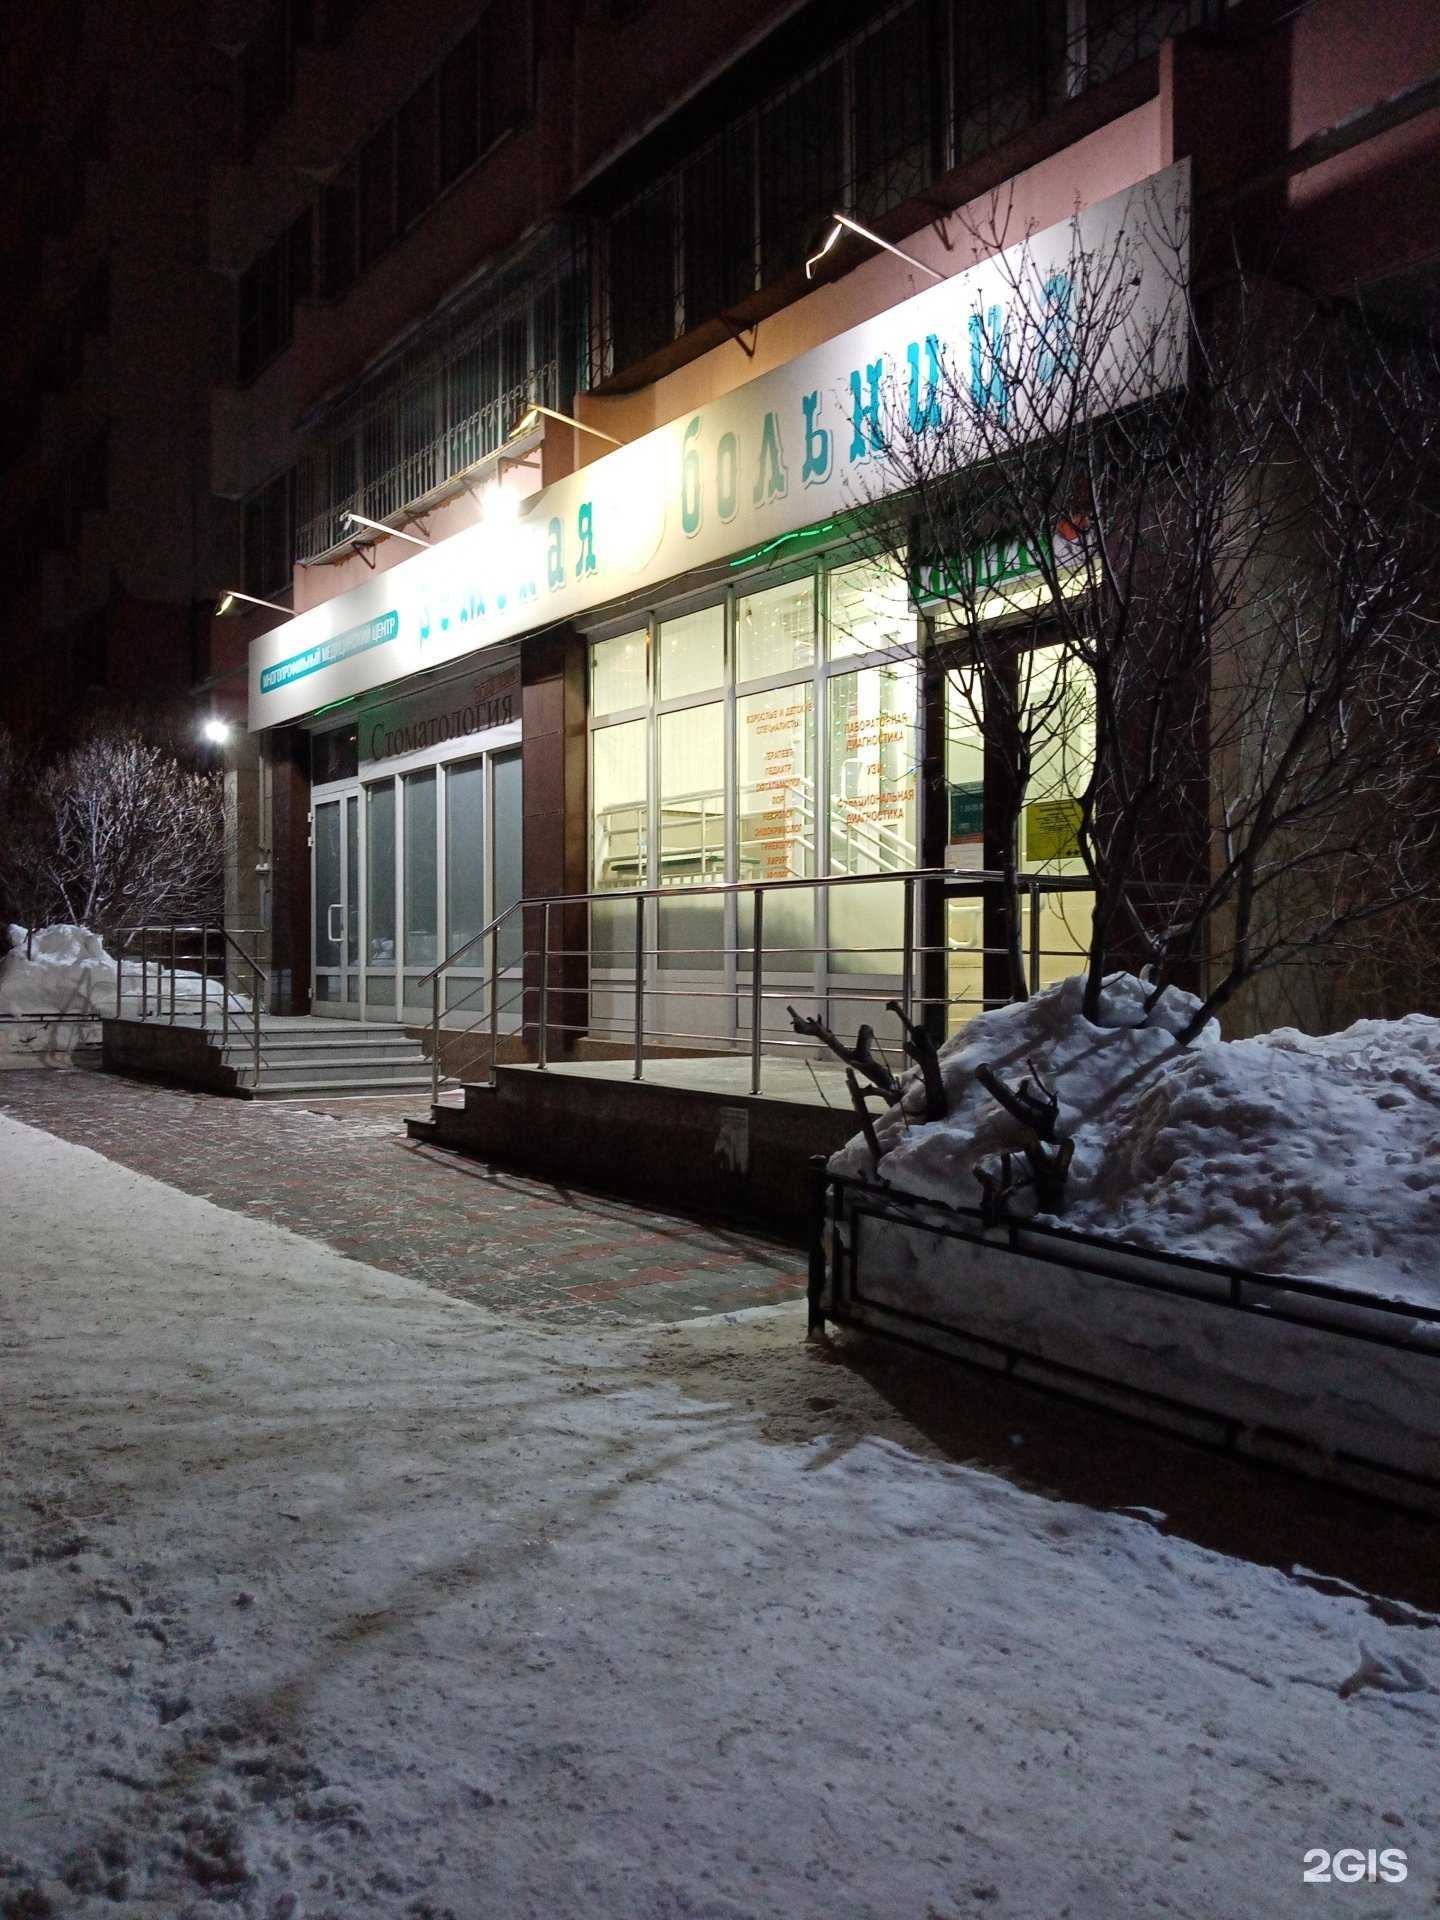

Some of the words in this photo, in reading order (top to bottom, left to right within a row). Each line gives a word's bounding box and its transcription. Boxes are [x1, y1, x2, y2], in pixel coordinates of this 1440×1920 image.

[372, 616, 396, 641] ЦЕНТР
[371, 694, 513, 761] Стоматология
[846, 808, 904, 825] ДИАГНОСТИКА
